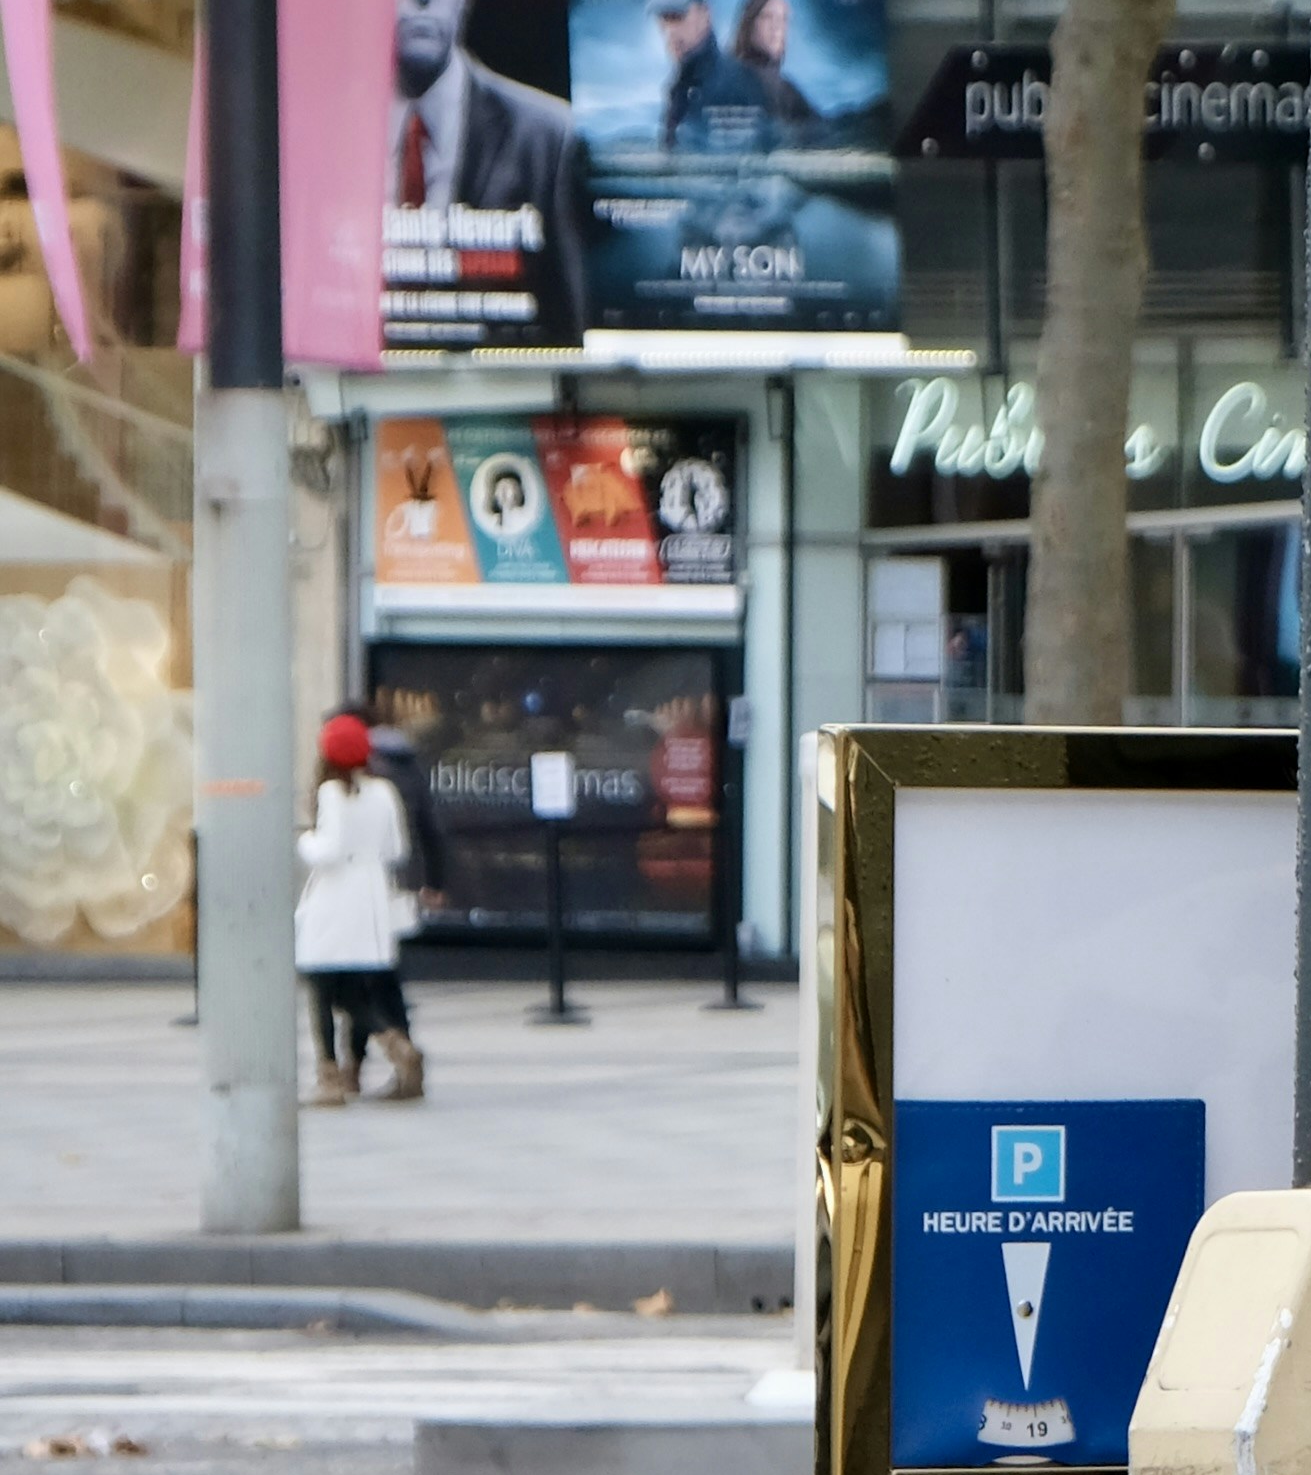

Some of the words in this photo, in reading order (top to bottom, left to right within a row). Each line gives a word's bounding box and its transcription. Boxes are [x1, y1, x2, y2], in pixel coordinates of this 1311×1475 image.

[1144, 71, 1308, 129] cinema
[680, 245, 730, 280] MY
[732, 245, 805, 281] SON
[1013, 1142, 1043, 1186] P
[923, 1210, 1003, 1233] HEURE
[1008, 1207, 1134, 1233] D'ARRIVÉE
[1027, 1421, 1048, 1438] 19
